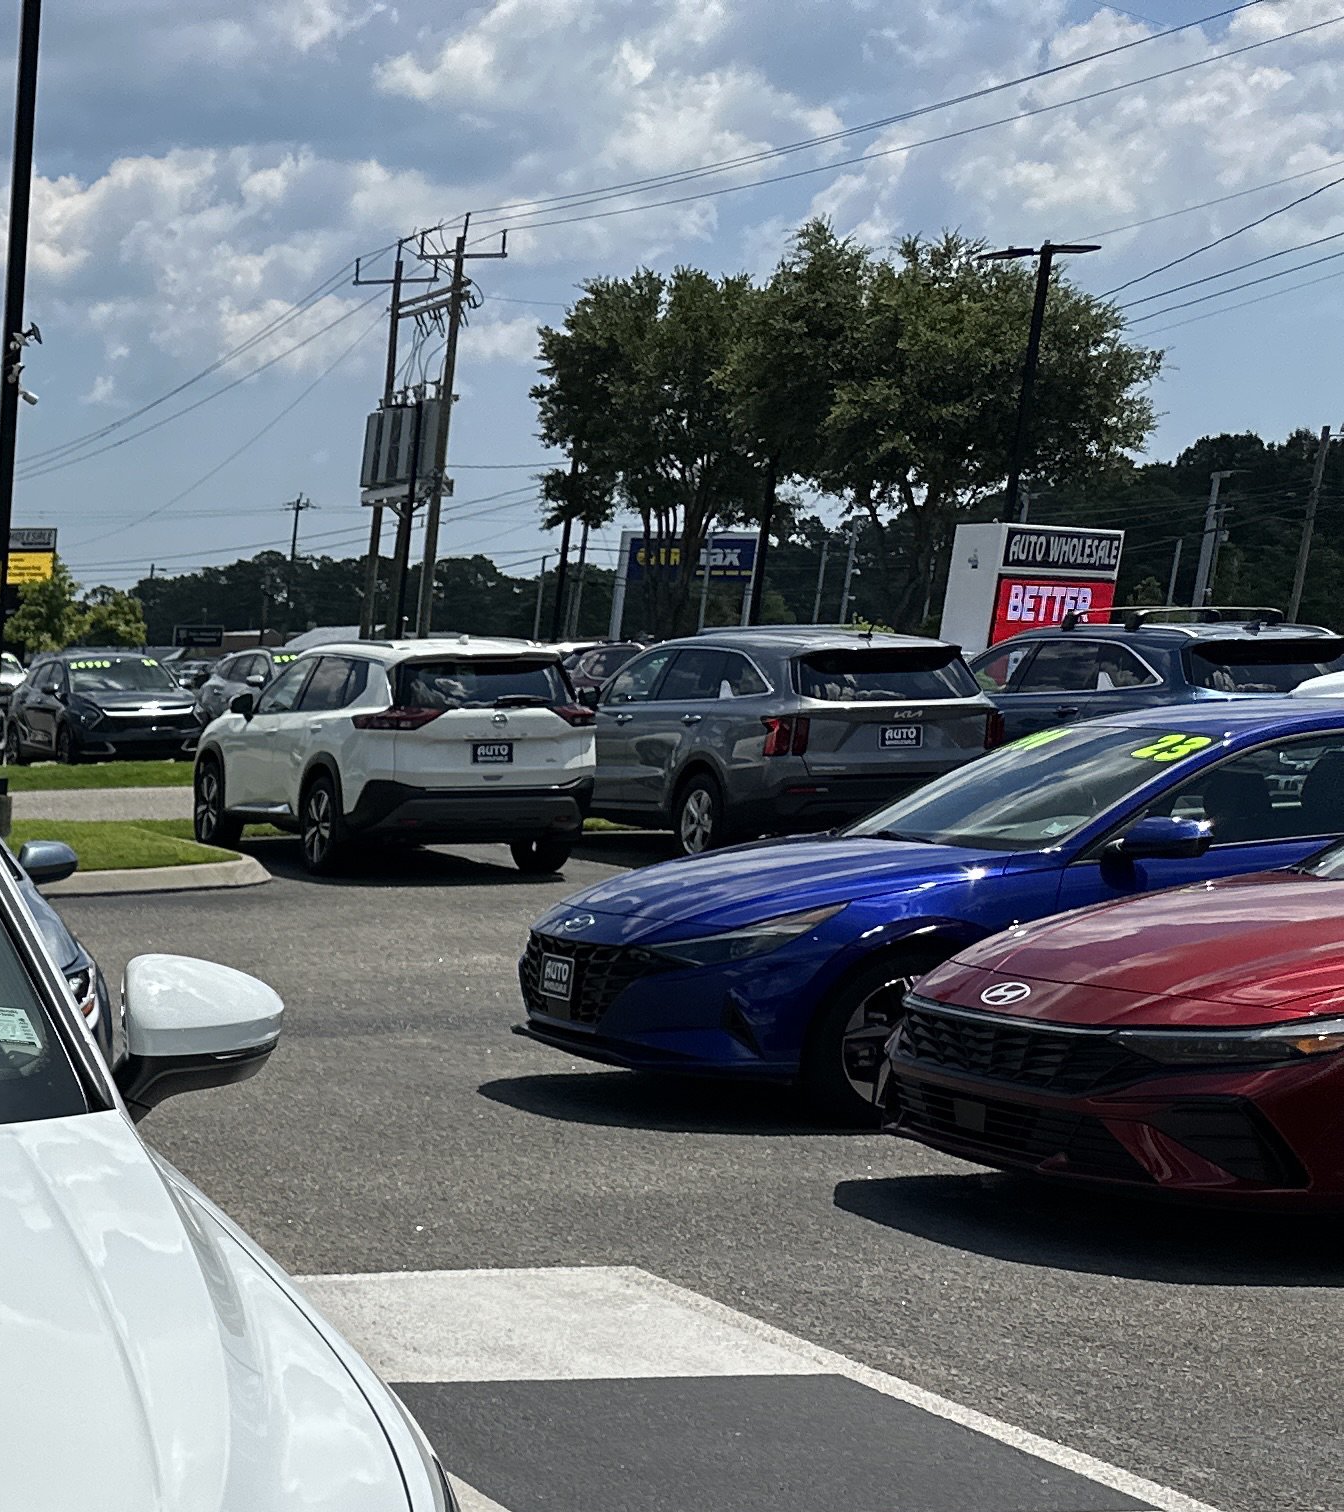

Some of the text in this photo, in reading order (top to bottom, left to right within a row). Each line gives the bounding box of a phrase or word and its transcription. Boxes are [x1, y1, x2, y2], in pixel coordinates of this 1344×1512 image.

[1009, 534, 1119, 566] AUTO WHOLESALE
[1007, 585, 1092, 622] BETTER
[885, 728, 916, 740] AUTO
[477, 745, 509, 755] AUTO
[1130, 734, 1212, 762] 23
[544, 960, 569, 982] AUTO
